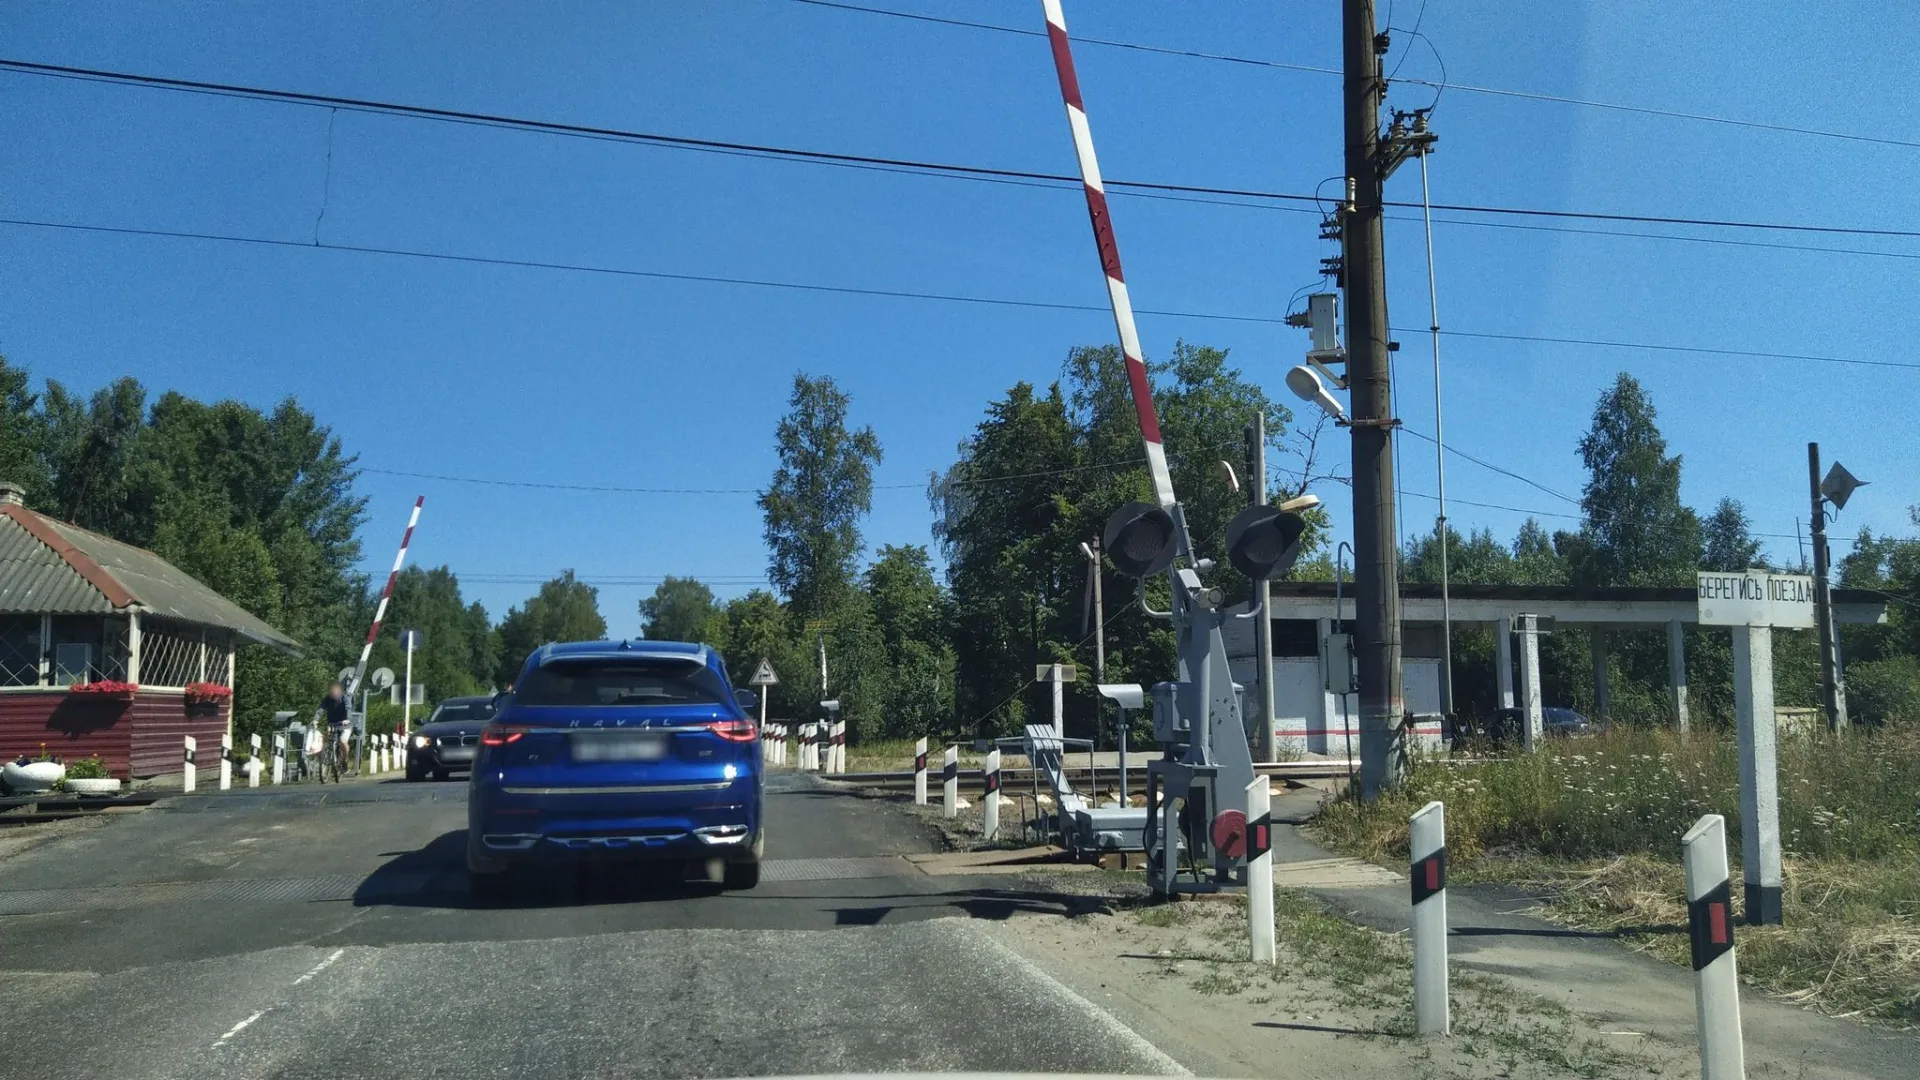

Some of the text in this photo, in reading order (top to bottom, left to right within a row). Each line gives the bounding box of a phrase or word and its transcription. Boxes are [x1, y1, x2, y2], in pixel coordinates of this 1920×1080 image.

[1698, 576, 1813, 604] БЕРЕГИСЬ ПОЕЗДА
[570, 719, 671, 727] HAVAL
